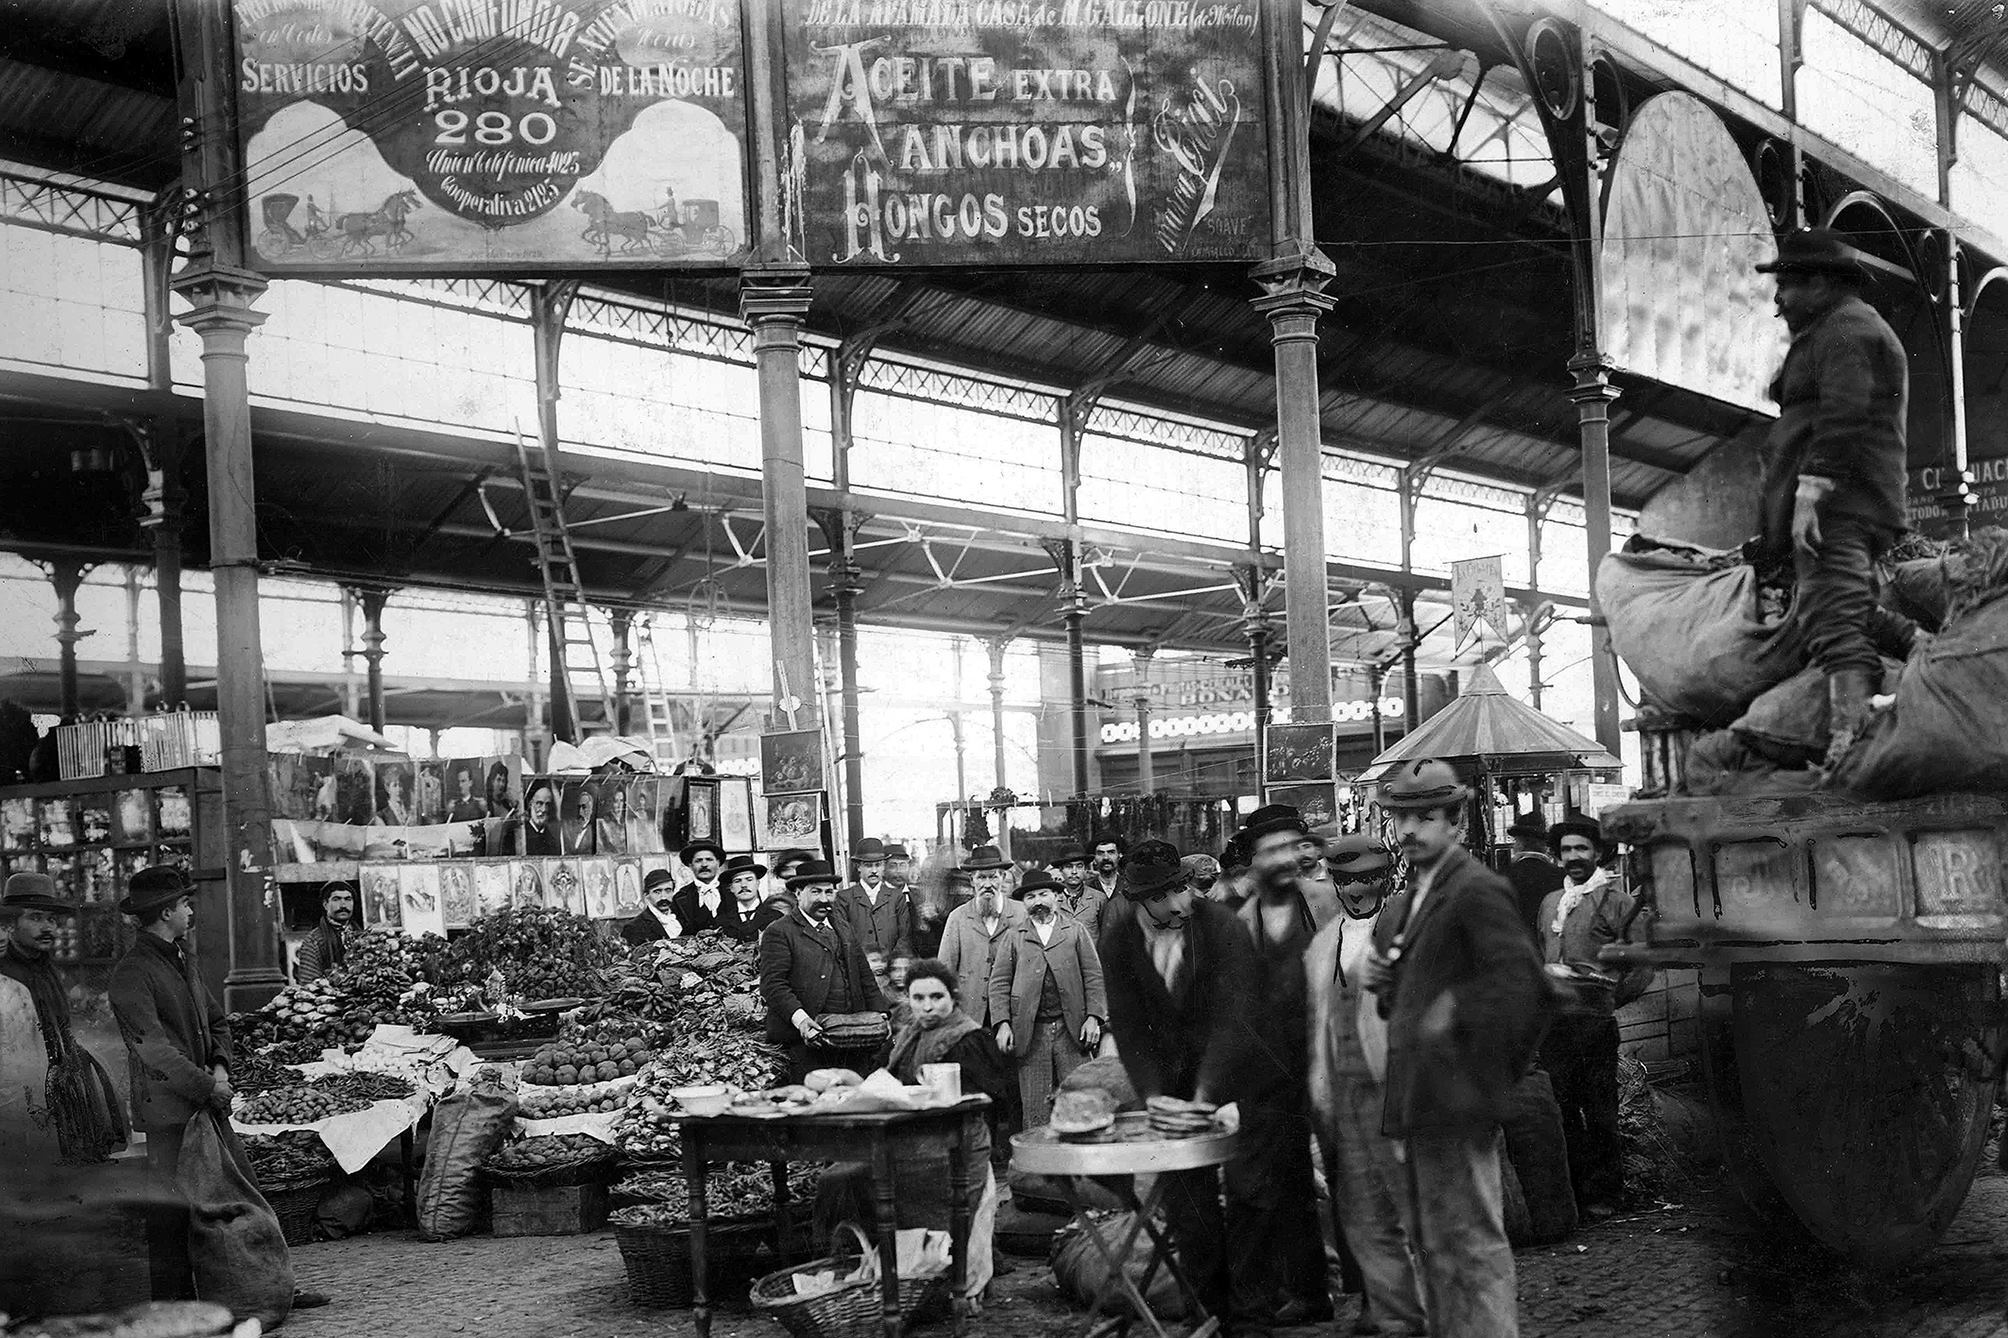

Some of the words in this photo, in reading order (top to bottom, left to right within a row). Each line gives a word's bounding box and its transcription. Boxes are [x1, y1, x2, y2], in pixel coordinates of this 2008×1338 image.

[241, 57, 369, 94] SERVICIOS
[423, 66, 562, 110] RIOJA
[600, 66, 624, 97] DE
[628, 66, 655, 97] LA
[657, 56, 735, 98] NOCHE
[809, 35, 998, 167] ACEITE
[1011, 68, 1118, 101] EXTRA
[434, 109, 557, 145] 280
[832, 146, 1010, 265] HONGOS
[1017, 204, 1102, 239] SECOS
